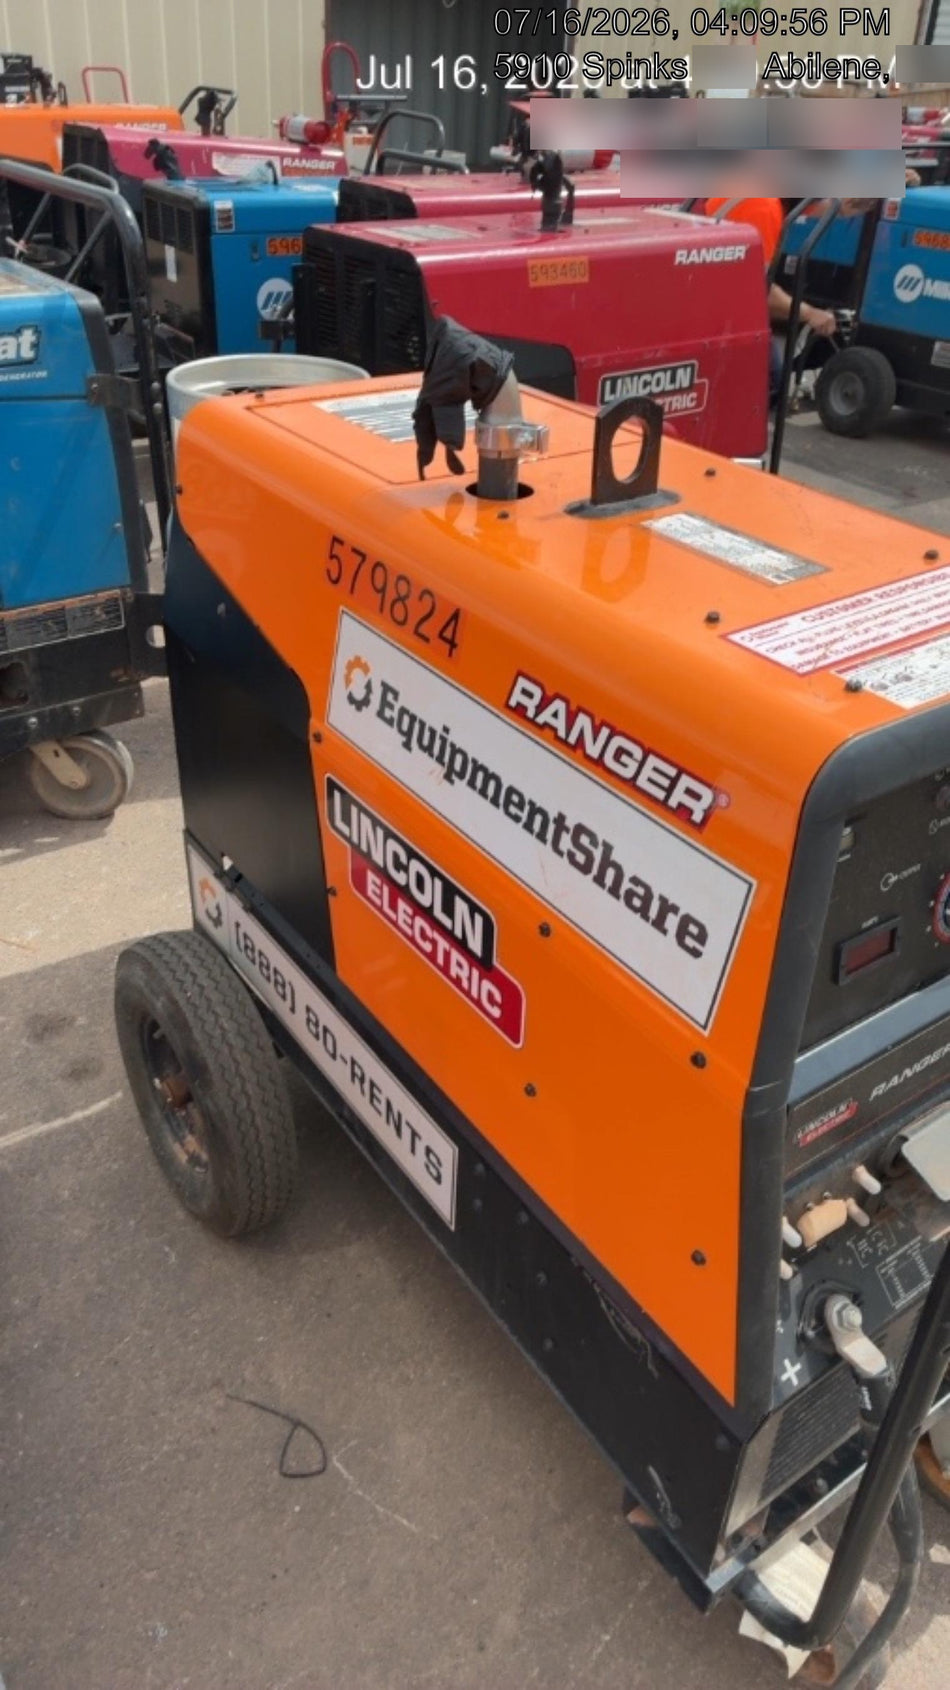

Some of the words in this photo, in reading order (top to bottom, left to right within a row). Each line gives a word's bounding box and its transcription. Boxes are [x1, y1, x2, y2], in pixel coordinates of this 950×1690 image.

[282, 157, 336, 171] RANGER
[673, 244, 747, 266] RANGER
[603, 366, 692, 403] LINCOLN
[326, 534, 461, 659] 579824
[376, 680, 709, 960] EquipmentShare
[506, 673, 719, 826] RANGER
[332, 786, 485, 958] LINCOLN
[366, 870, 503, 1021] ELECTRIC
[305, 1005, 444, 1186] 80-RENTS
